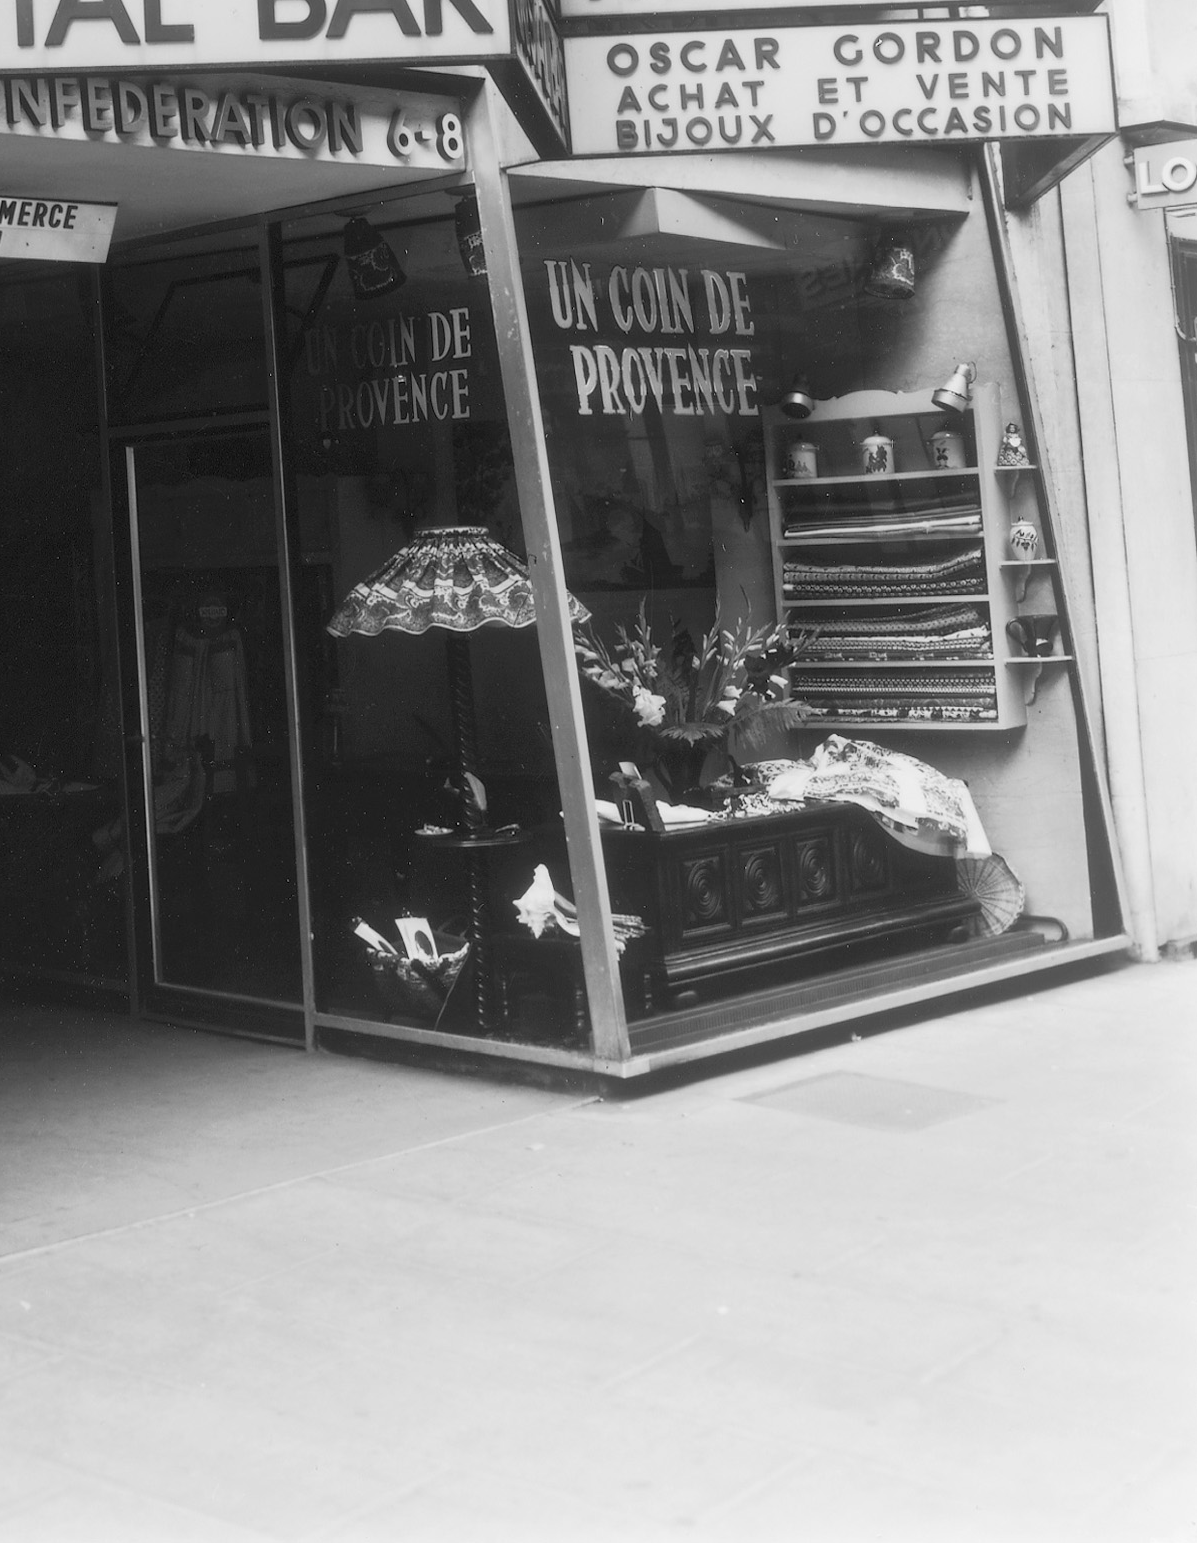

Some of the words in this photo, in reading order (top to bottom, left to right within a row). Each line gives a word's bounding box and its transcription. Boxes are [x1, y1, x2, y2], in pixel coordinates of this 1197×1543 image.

[606, 37, 781, 77] OSCAR
[832, 26, 1064, 67] GORDON
[617, 79, 765, 114] ACHAT
[817, 76, 869, 104] ET
[916, 69, 1069, 100] VENTE
[386, 108, 465, 160] 6-8
[615, 113, 777, 149] BIJOUX
[812, 103, 1072, 141] D'OCCASION
[543, 256, 598, 330] UN
[608, 261, 696, 335] COIN
[701, 268, 755, 337] DE
[351, 312, 417, 370] COIN
[427, 306, 472, 363] DE
[319, 368, 471, 433] PROVENCE
[569, 343, 760, 417] PROVENCE
